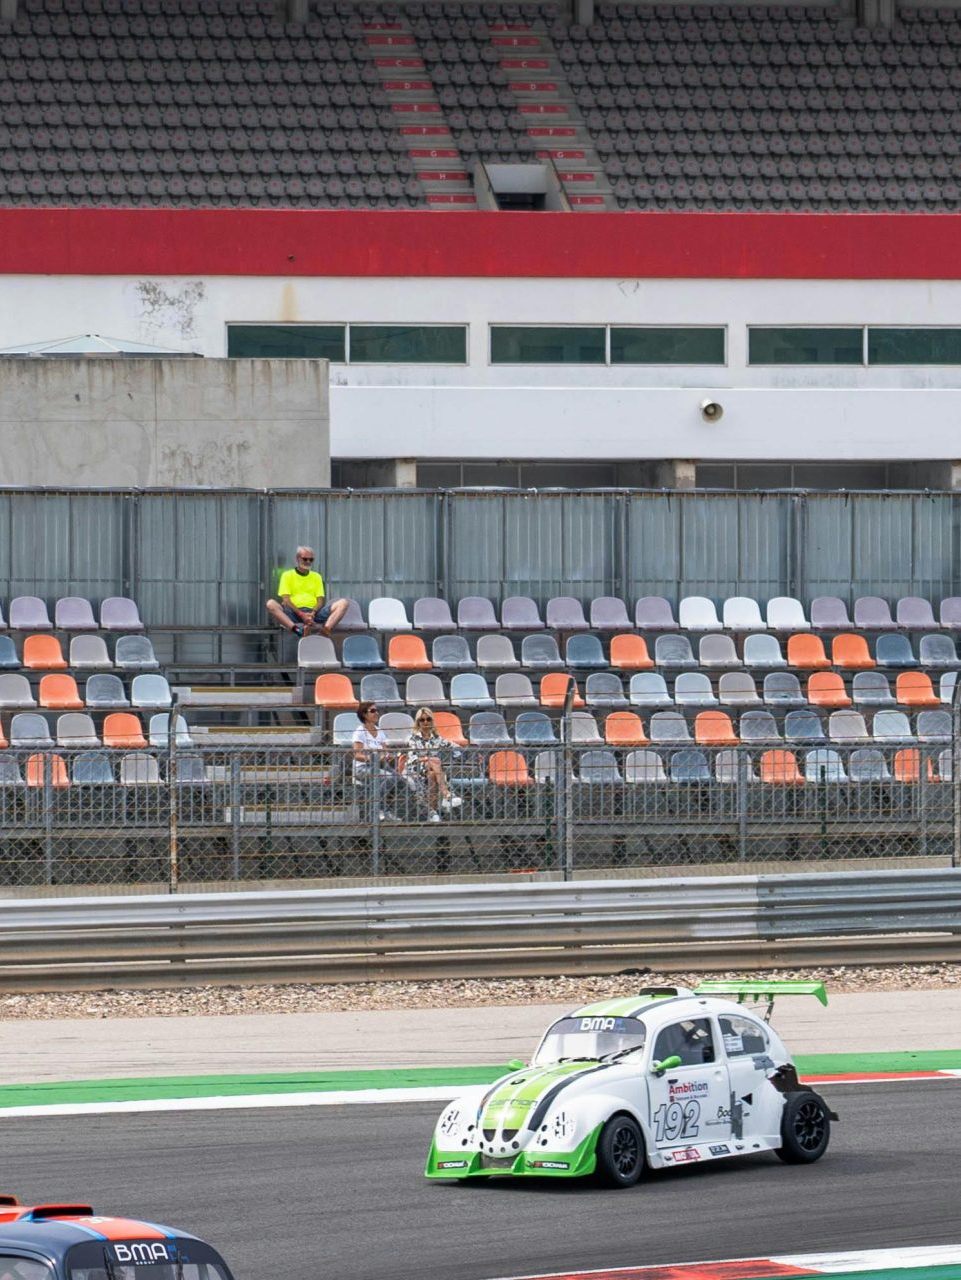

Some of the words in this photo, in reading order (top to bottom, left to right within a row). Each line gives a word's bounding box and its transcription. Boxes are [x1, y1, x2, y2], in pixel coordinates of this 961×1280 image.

[580, 1018, 616, 1031] BMA
[670, 1080, 708, 1095] Ambition
[653, 1099, 701, 1142] 192
[113, 1242, 169, 1262] BMA
